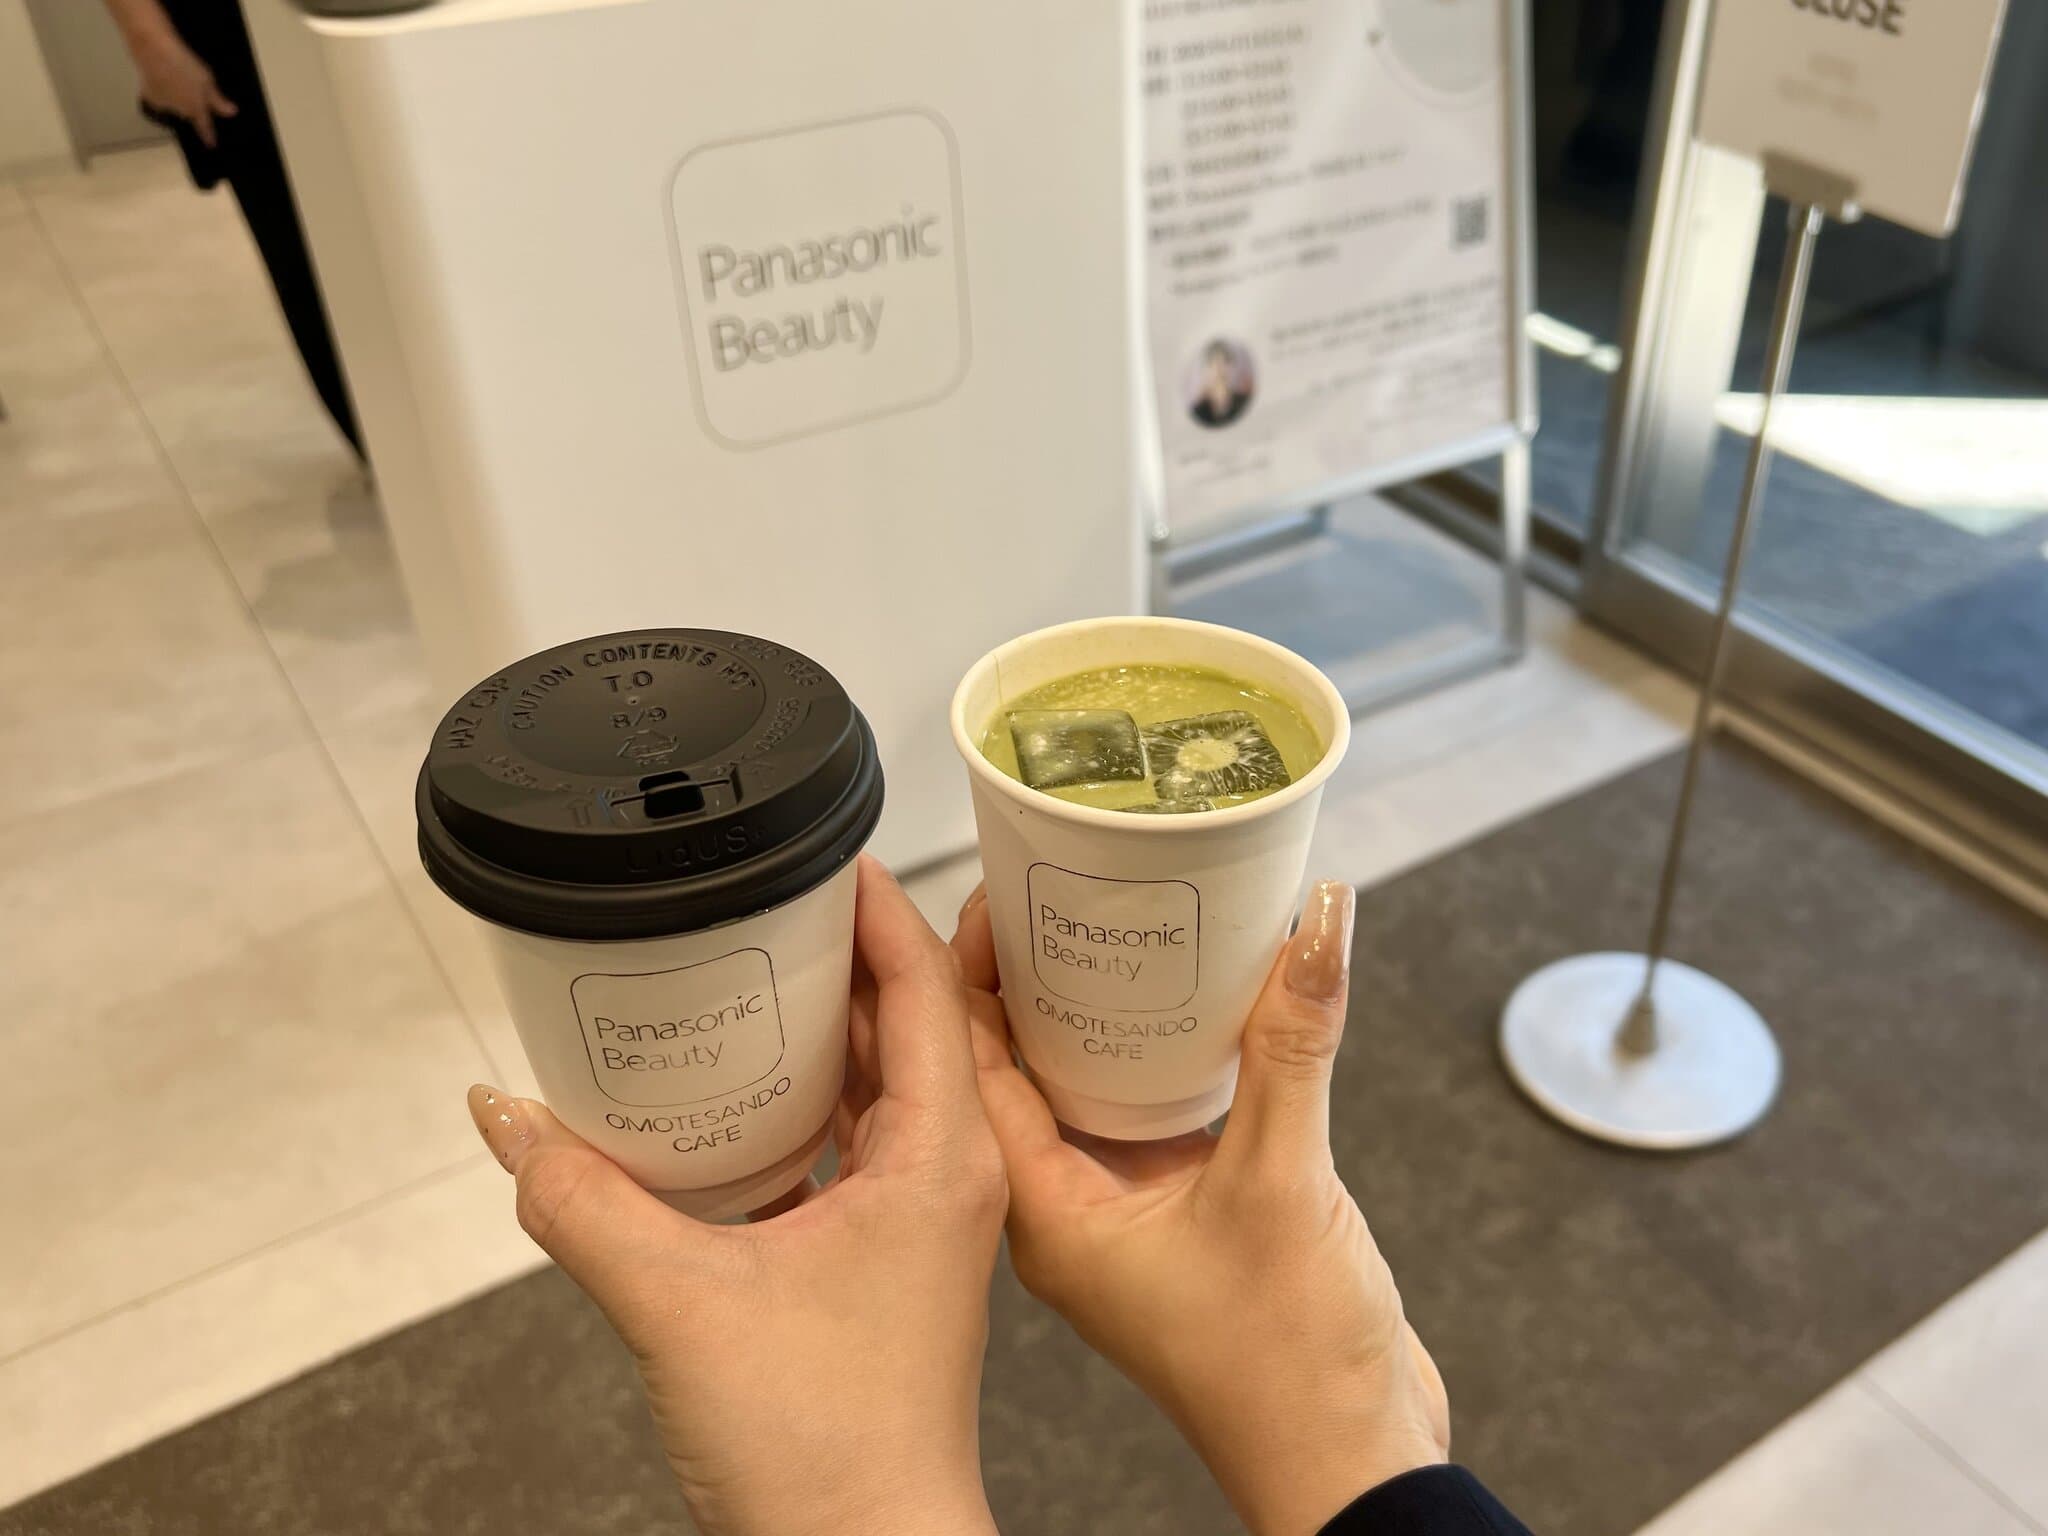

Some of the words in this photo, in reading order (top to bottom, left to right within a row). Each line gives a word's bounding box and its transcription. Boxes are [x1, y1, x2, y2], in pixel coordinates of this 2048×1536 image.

[698, 203, 941, 302] Panasonic
[707, 295, 884, 372] Beauty
[511, 664, 575, 730] CAUTION
[583, 643, 717, 667] CONTENTS
[1041, 904, 1185, 948] Panasonic
[1043, 935, 1143, 982] Beauty
[594, 994, 763, 1042] Panasonic
[1036, 997, 1197, 1038] OMOTESANDO
[602, 1041, 723, 1071] Beauty
[1083, 1038, 1143, 1060] CAFE
[606, 1077, 791, 1132] OMOTESANDO
[672, 1124, 742, 1153] CAFE
